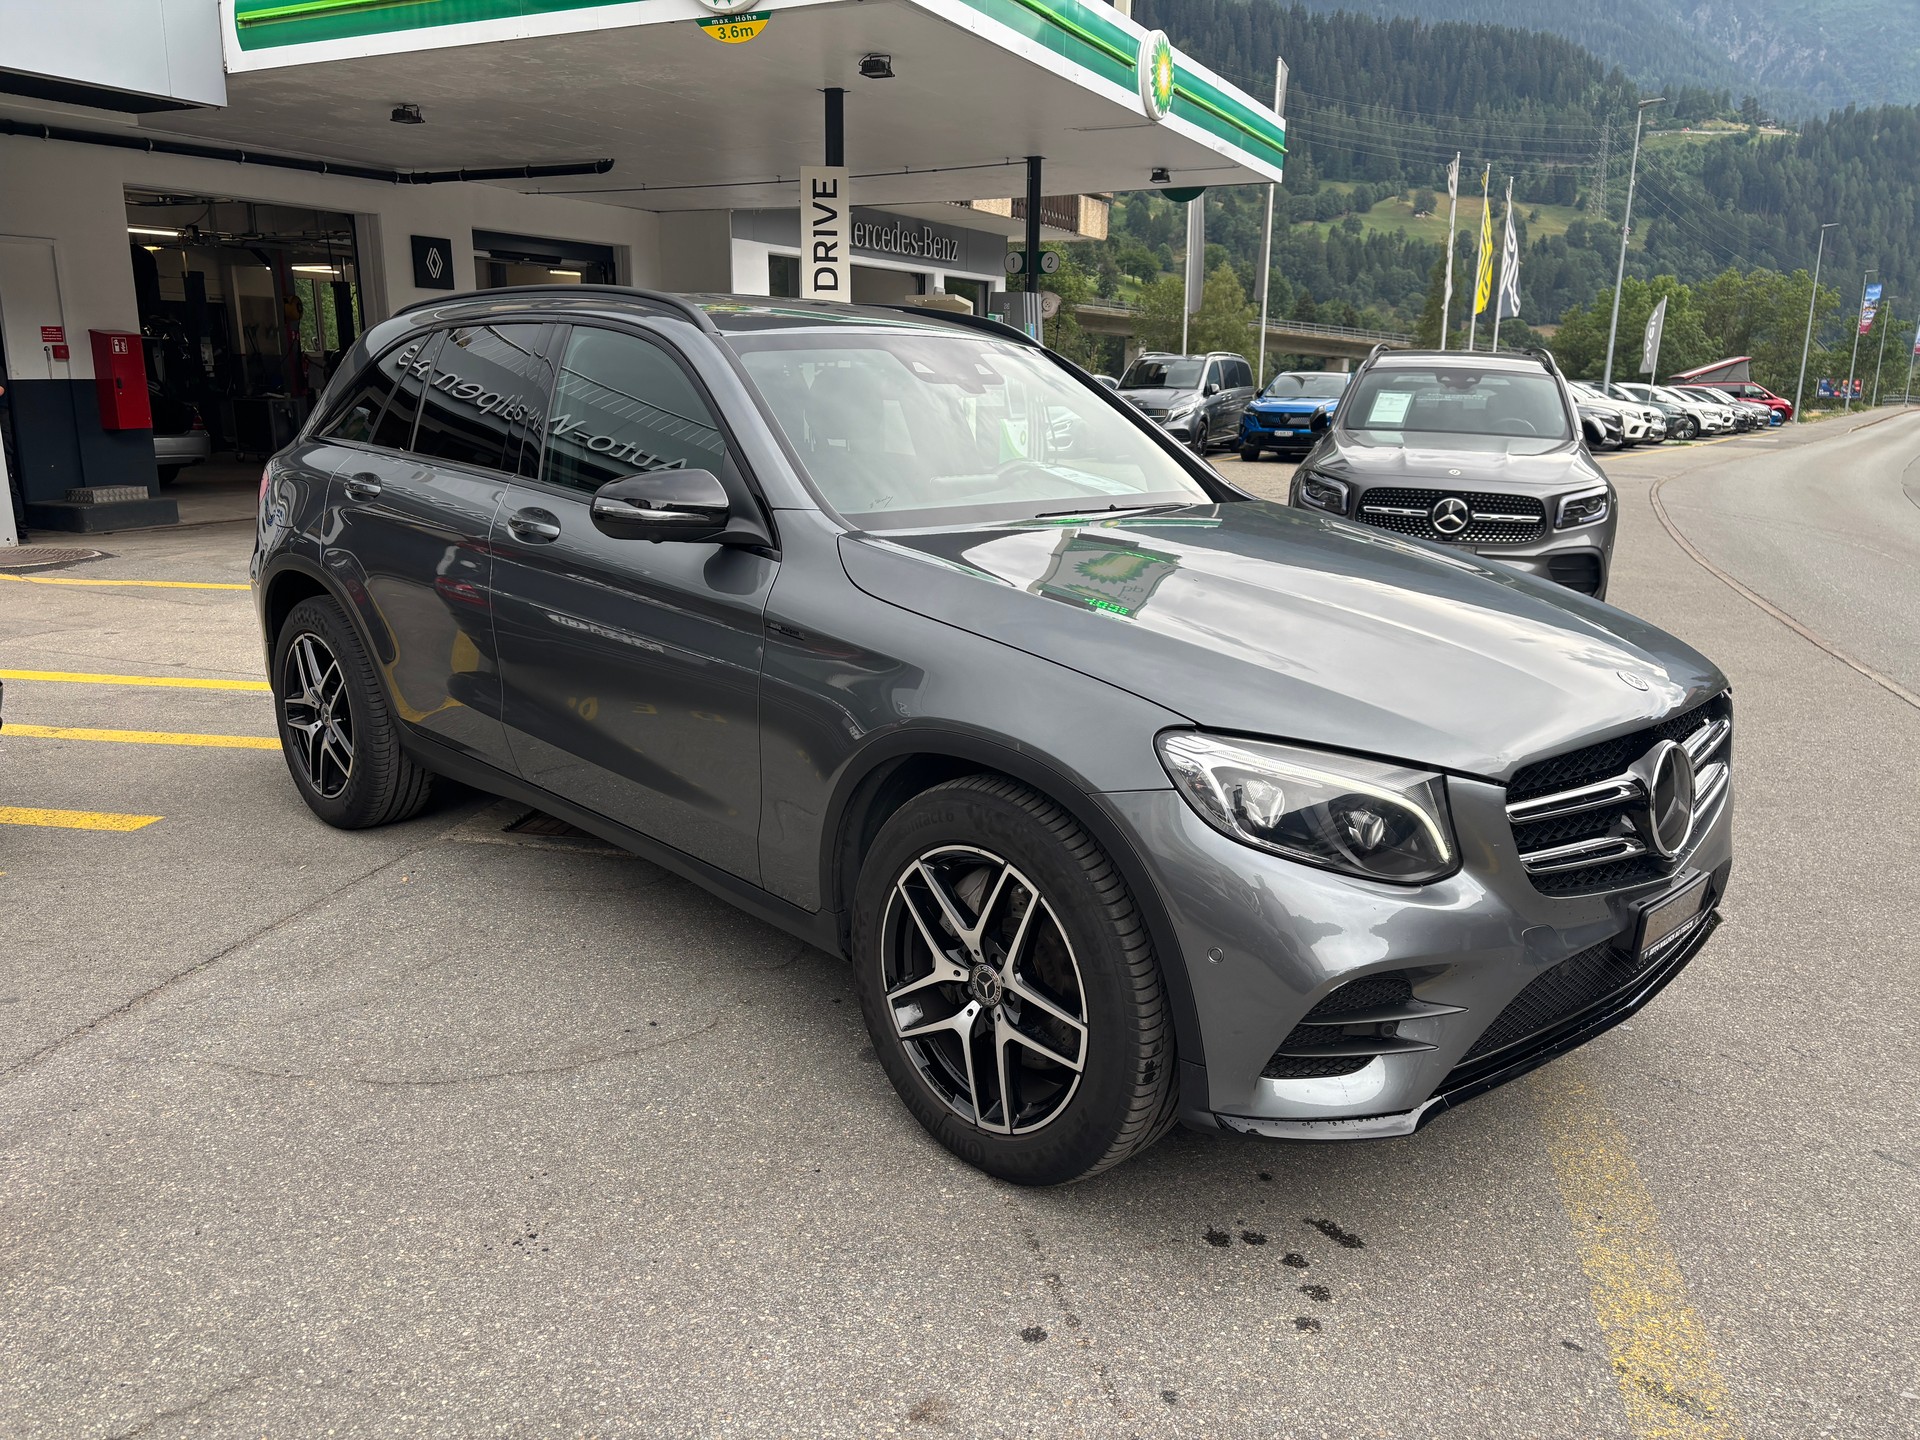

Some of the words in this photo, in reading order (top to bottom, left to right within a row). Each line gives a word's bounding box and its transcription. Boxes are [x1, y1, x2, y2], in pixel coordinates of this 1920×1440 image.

[735, 14, 757, 22] Höhe
[717, 25, 754, 40] 3.6m
[812, 178, 839, 292] DRIVE
[850, 212, 959, 262] ercedes-Benz
[1010, 257, 1016, 269] 1
[1046, 256, 1054, 269] 2
